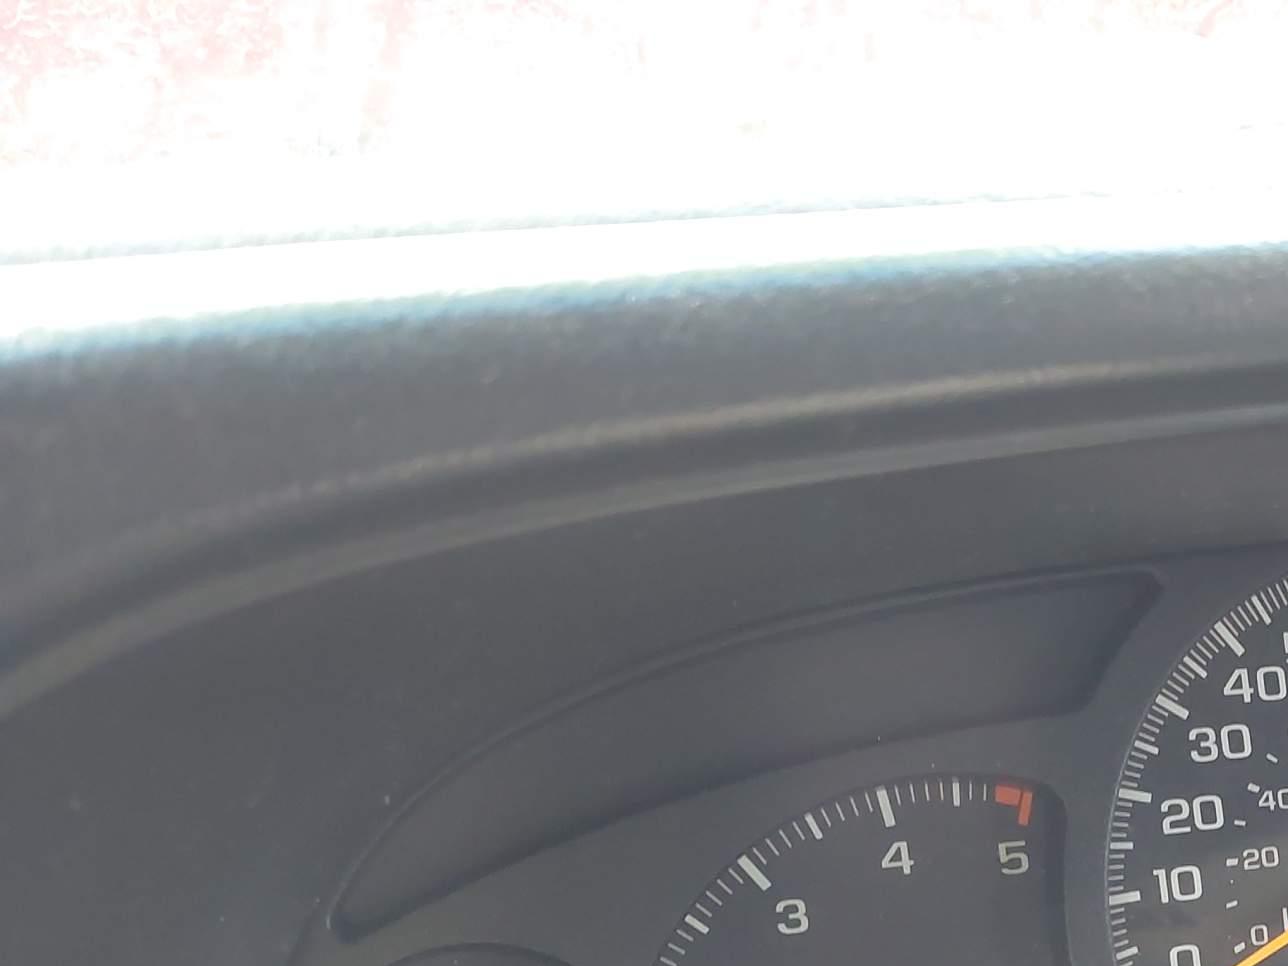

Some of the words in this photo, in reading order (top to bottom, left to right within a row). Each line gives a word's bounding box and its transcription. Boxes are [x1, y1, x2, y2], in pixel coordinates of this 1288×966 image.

[1223, 666, 1287, 703] 40
[1188, 724, 1252, 763] 30
[1160, 795, 1224, 835] 20
[881, 841, 914, 875] 4
[998, 840, 1029, 875] 5
[1242, 846, 1279, 870] 20
[1152, 865, 1203, 904] 10
[775, 899, 809, 935] 3
[1250, 924, 1269, 946] 0
